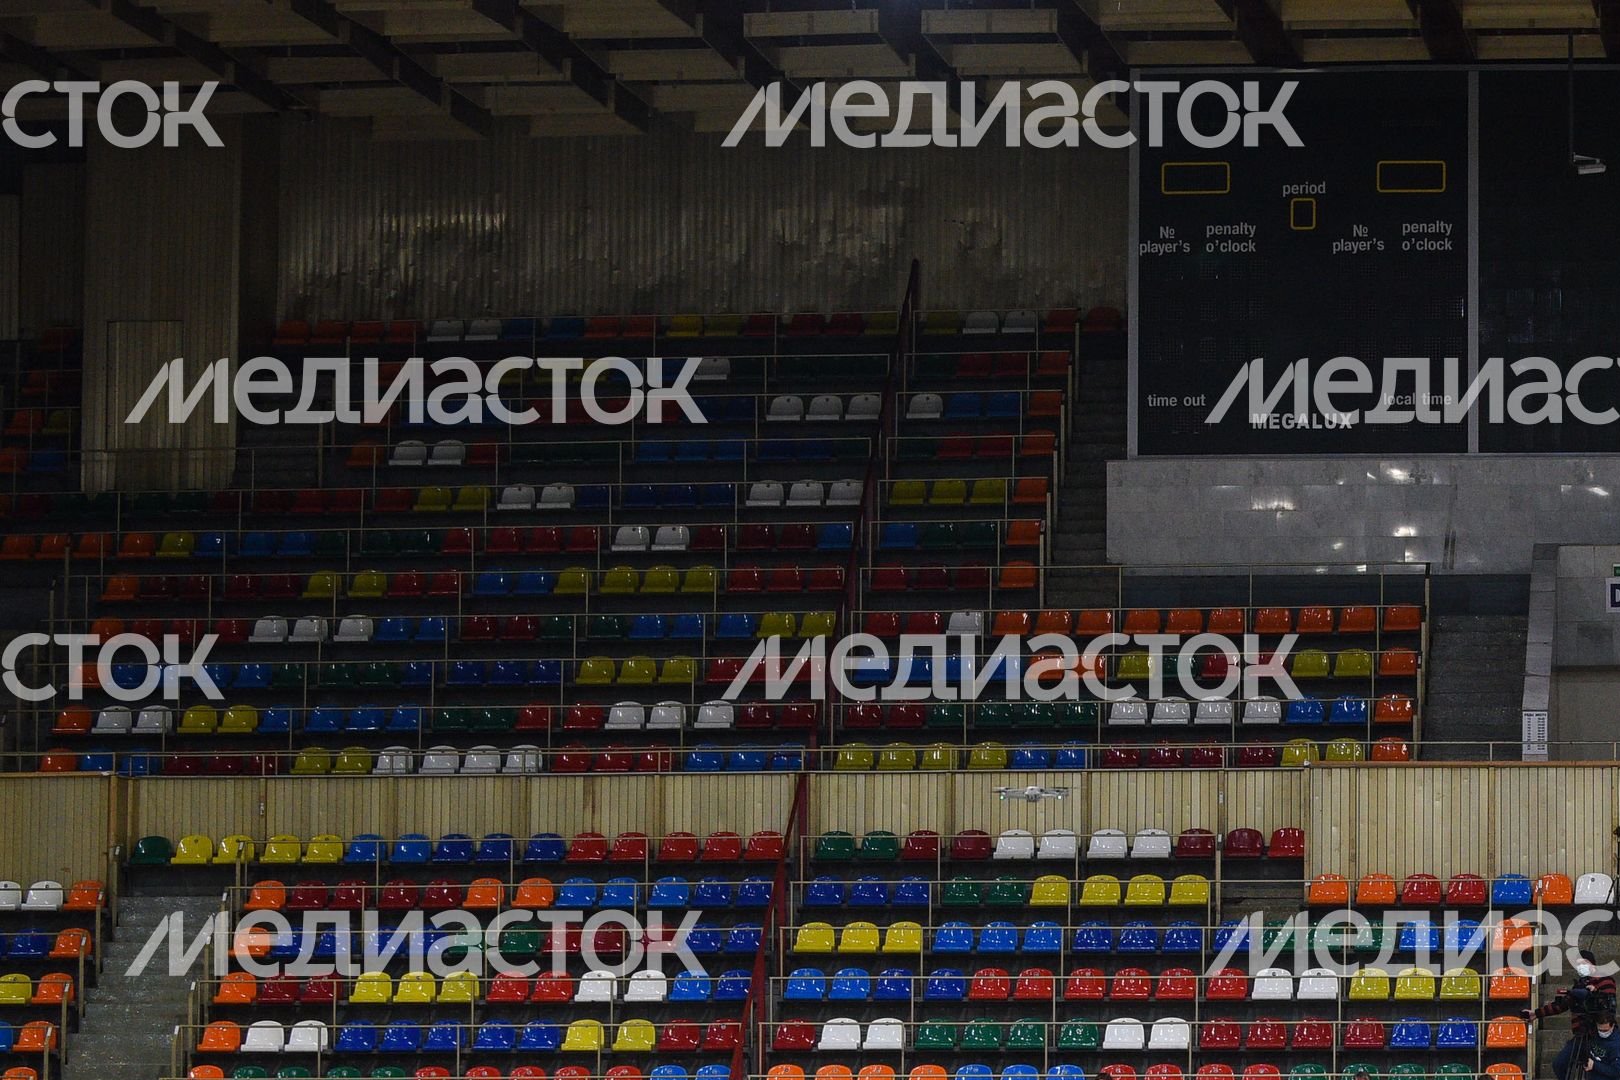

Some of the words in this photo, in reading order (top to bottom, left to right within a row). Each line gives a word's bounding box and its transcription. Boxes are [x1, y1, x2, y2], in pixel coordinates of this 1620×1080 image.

[1282, 181, 1326, 197] period
[1206, 222, 1257, 238] penalty
[1402, 220, 1453, 236] penalty
[1147, 394, 1178, 407] time
[1183, 394, 1206, 407] out
[1383, 392, 1416, 406] local
[1421, 392, 1452, 406] time
[1252, 413, 1353, 430] MEGALUX
